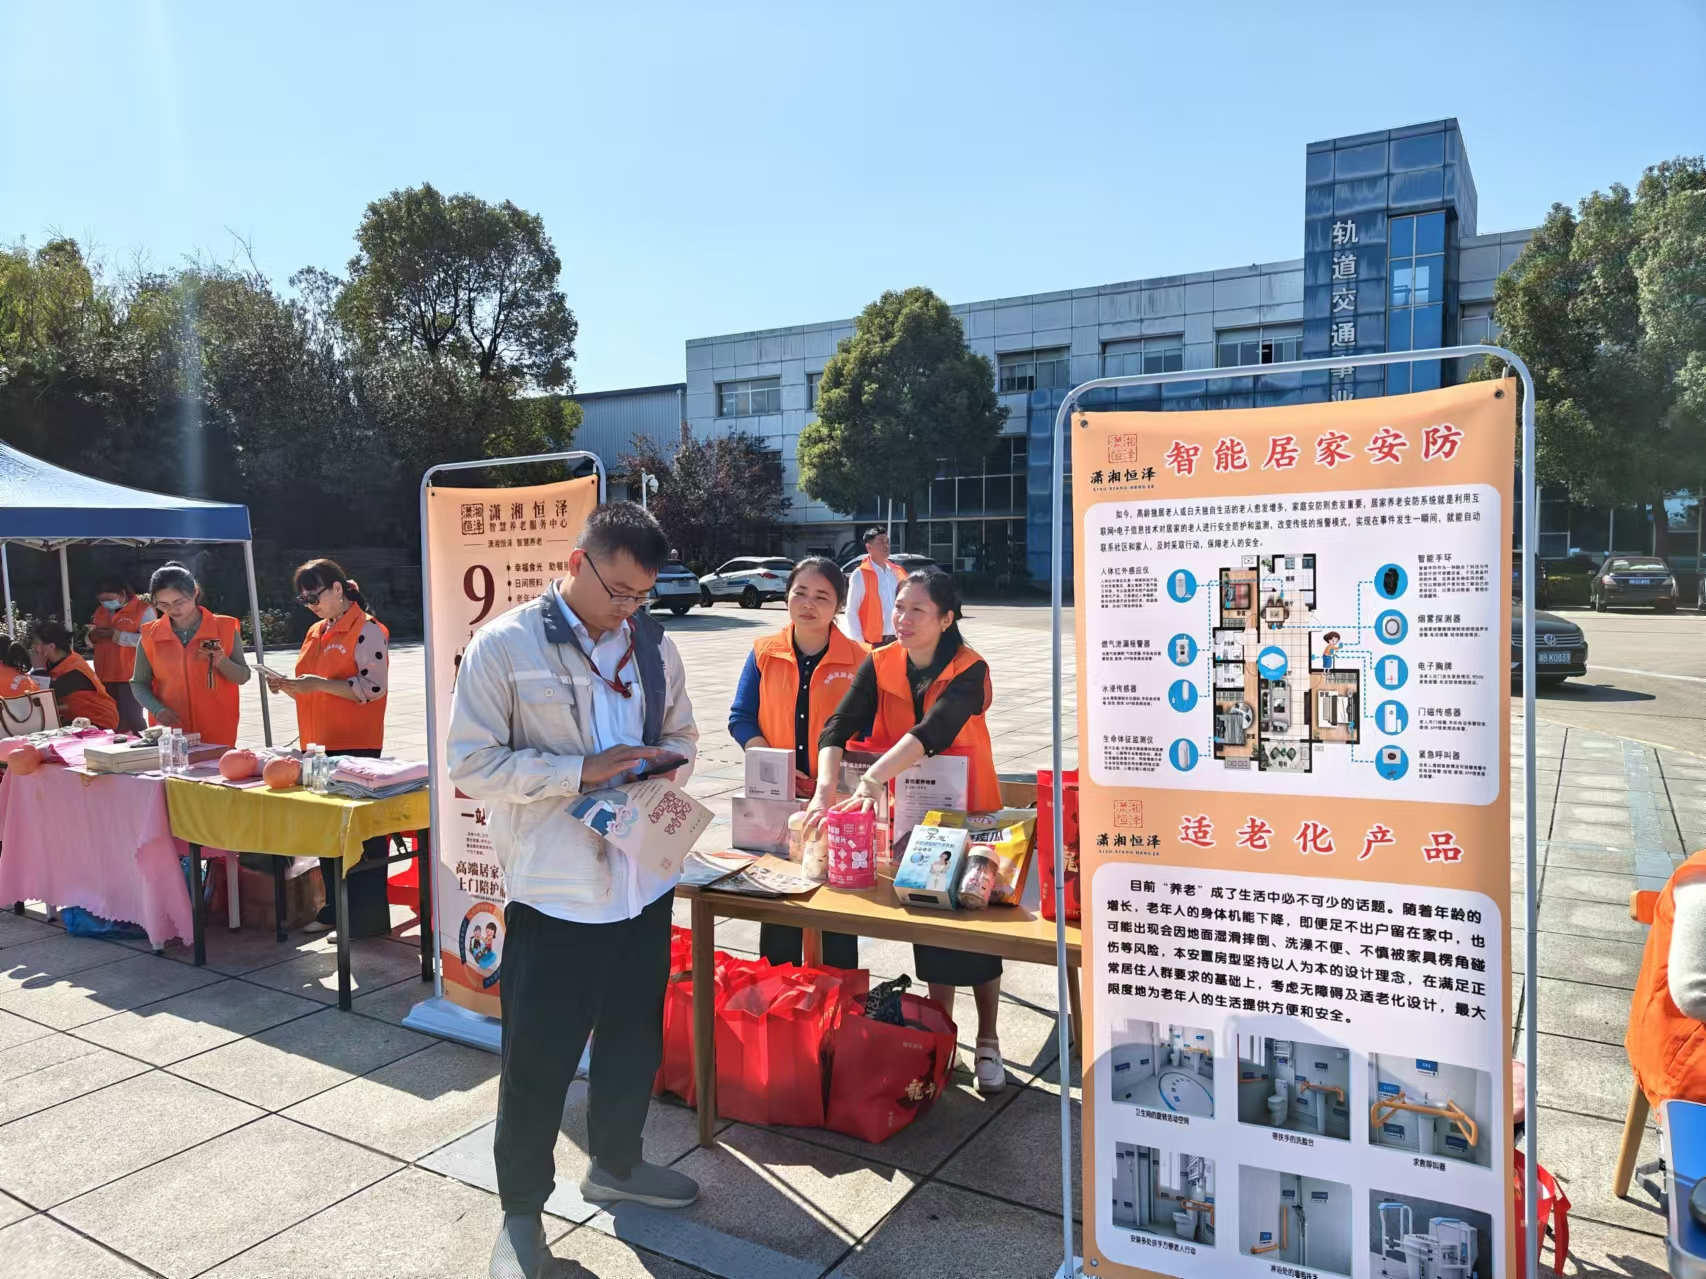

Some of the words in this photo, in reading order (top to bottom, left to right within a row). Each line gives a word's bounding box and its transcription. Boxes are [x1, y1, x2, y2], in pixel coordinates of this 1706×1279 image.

[1165, 424, 1464, 476] 智能居家安防
[1091, 467, 1156, 484] 潇湘恒泽
[489, 500, 567, 521] 潇湘恒泽
[489, 519, 568, 532] 智慧养老服务中心
[1418, 553, 1452, 563] 智能手环
[515, 563, 543, 573] 幸福食光
[1101, 566, 1150, 576] 人体红外感应仪
[515, 579, 543, 588] 日间照料
[464, 565, 495, 625] 9
[1418, 614, 1461, 624] 烟雾探测器
[1418, 662, 1453, 671] 电子胸牌
[1102, 685, 1137, 693] 水浸传感器
[1418, 707, 1461, 717] 门磁传感器
[1103, 735, 1154, 744] 生命体征监测仪
[1419, 750, 1460, 760] 紧急呼叫器
[1096, 833, 1161, 849] 潇湘恒泽
[1179, 815, 1464, 863] 适老化产品
[456, 861, 504, 879] 高端居家
[1107, 900, 1485, 948] 增长，老年人的身体机能下降，即便足不出户留在家中，也
[1107, 942, 1486, 996] 伤等风险，本安置房型坚持以人为本的设计理念，在满足正
[1107, 962, 1487, 1020] 常居住人群要求的基础上，考虑无障碍及适老化设计，最大
[1107, 983, 1352, 1024] 限度地为老年人的生活提供方便和安全。
